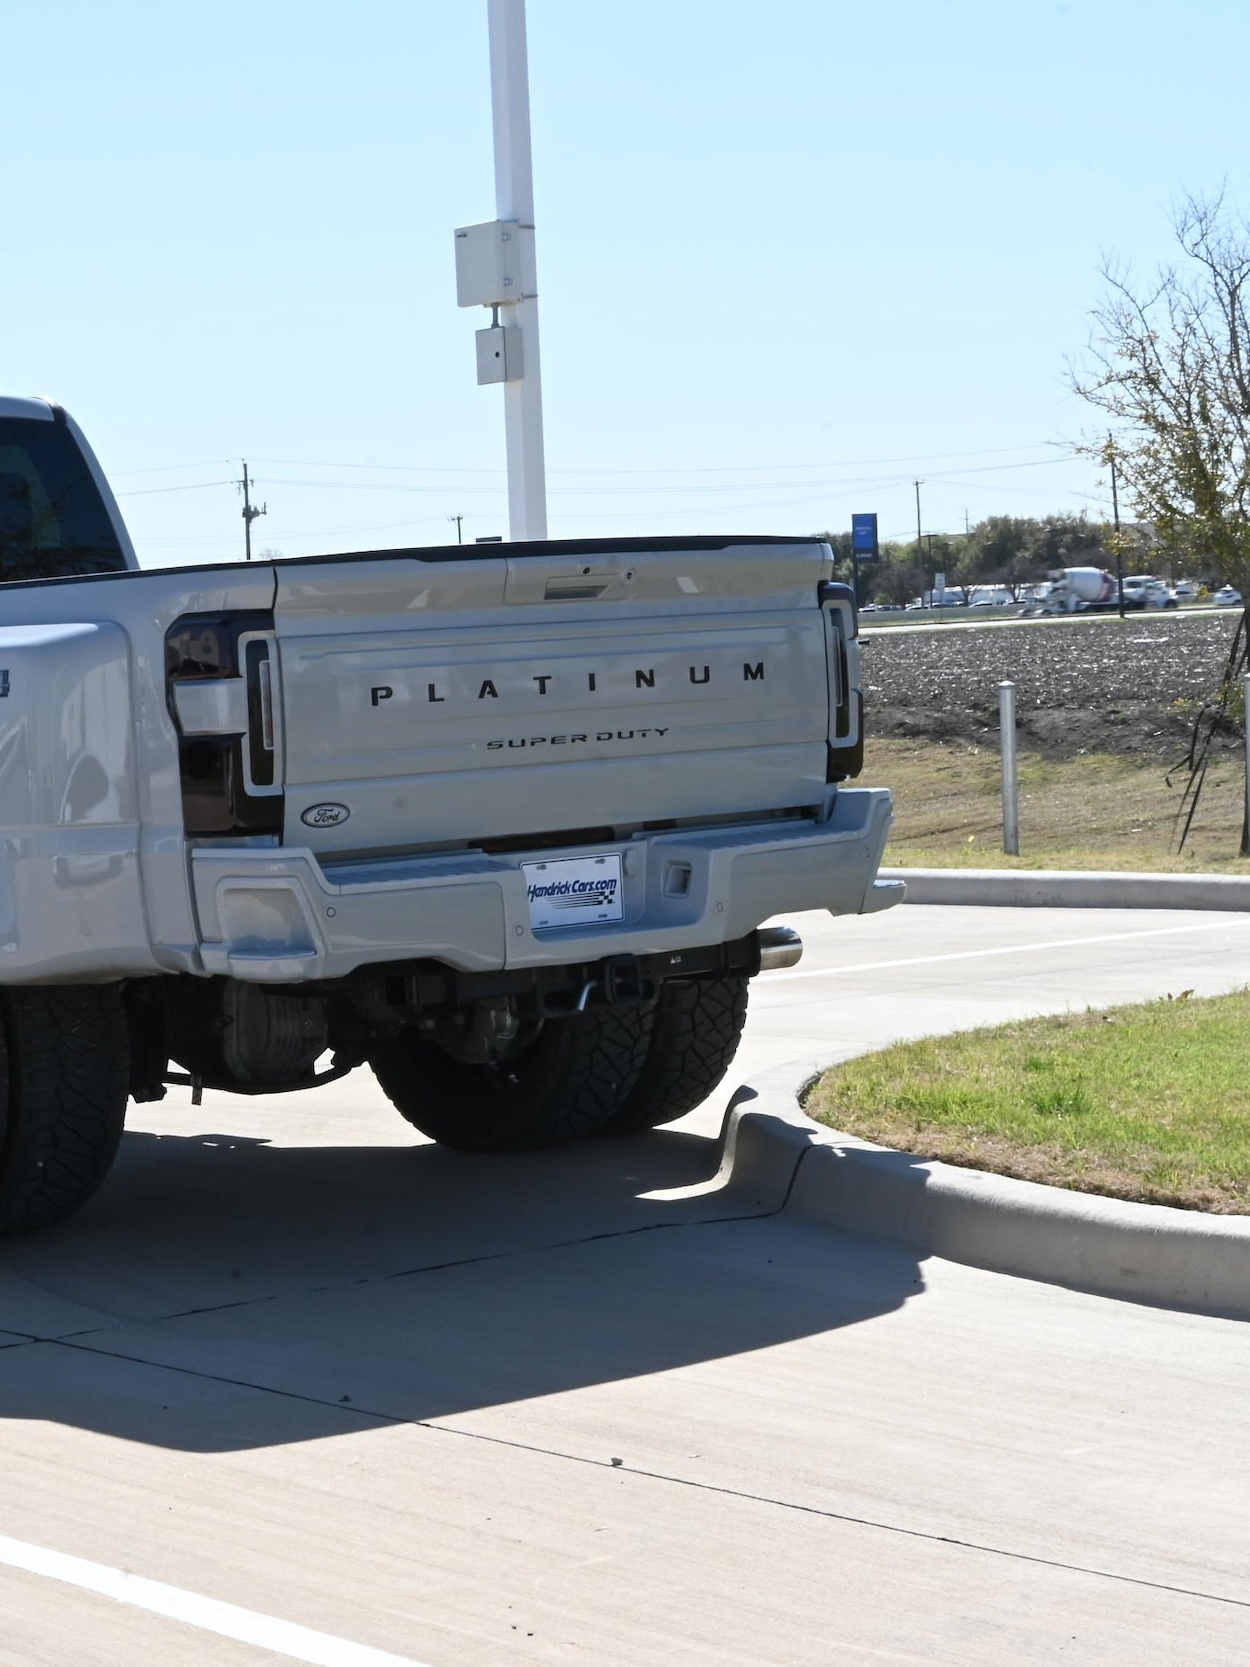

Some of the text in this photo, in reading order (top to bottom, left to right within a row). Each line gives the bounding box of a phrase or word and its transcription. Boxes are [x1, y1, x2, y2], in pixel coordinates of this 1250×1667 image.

[370, 662, 765, 706] PLATINUM
[486, 727, 669, 750] SUPER DUTY
[314, 808, 340, 823] Ford
[527, 879, 617, 903] Hendrick Cars.com
